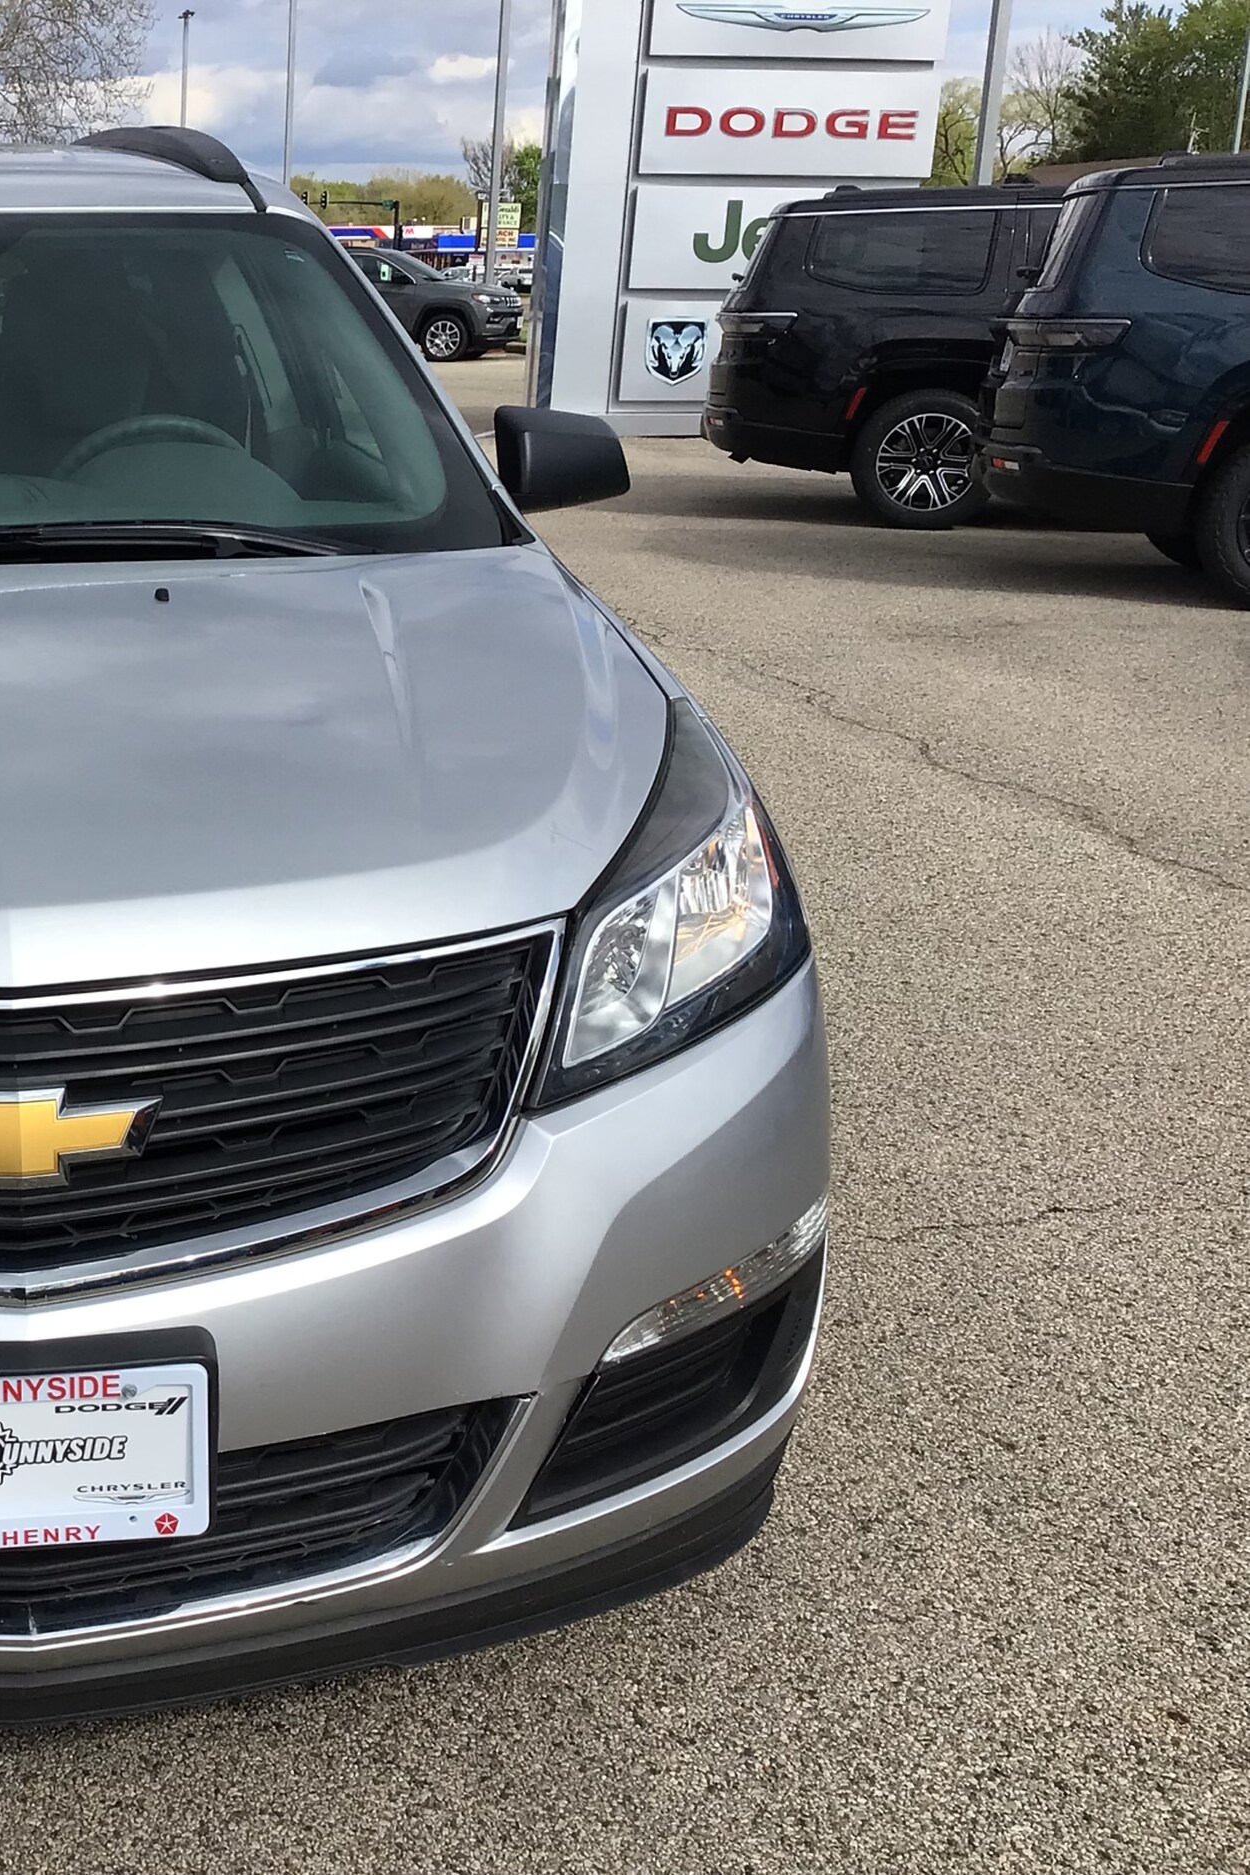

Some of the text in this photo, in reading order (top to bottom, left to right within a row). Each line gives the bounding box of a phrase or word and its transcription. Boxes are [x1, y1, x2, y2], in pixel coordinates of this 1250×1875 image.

[664, 106, 919, 140] DODGE
[55, 1401, 169, 1414] DODGE
[77, 1481, 186, 1493] CHRYSLER
